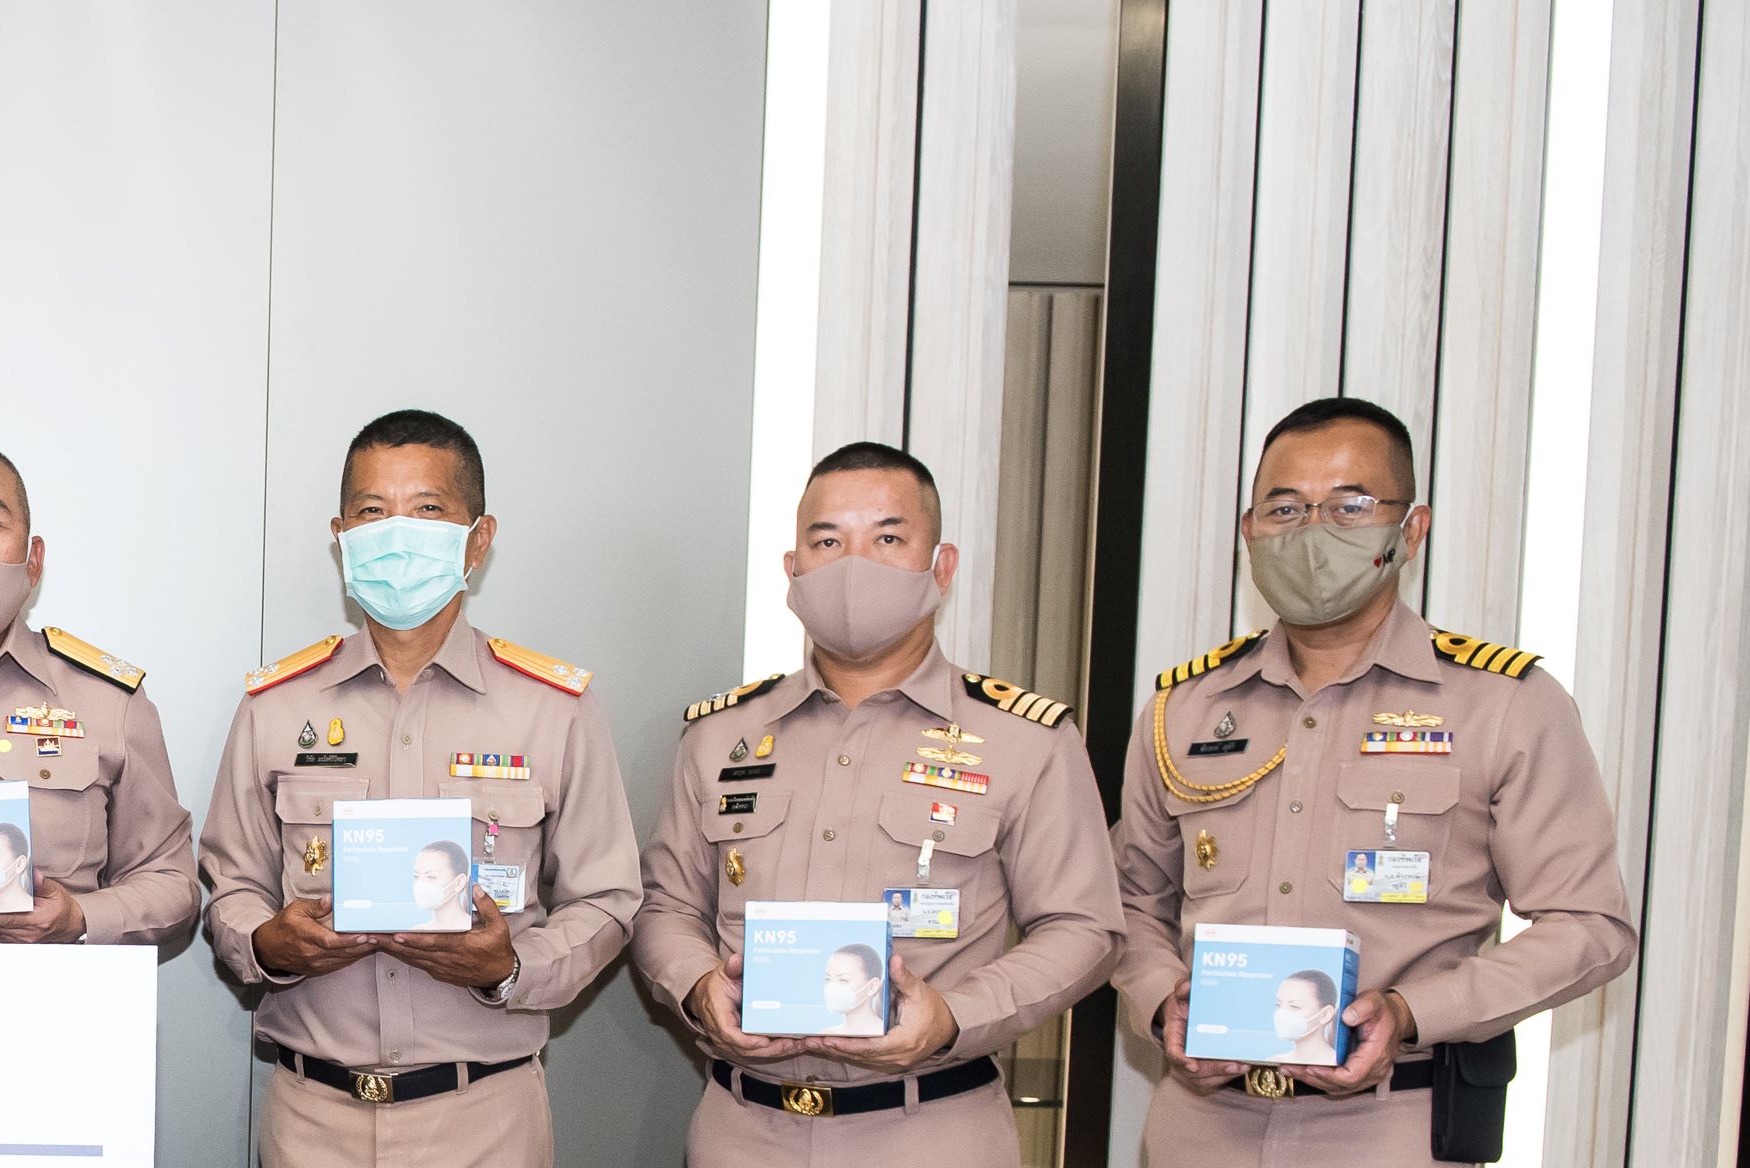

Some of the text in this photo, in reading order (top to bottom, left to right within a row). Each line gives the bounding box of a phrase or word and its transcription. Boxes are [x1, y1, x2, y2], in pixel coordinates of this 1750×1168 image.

[343, 829, 385, 843] KN95
[754, 930, 797, 944] KN95
[1202, 952, 1248, 967] KN95
